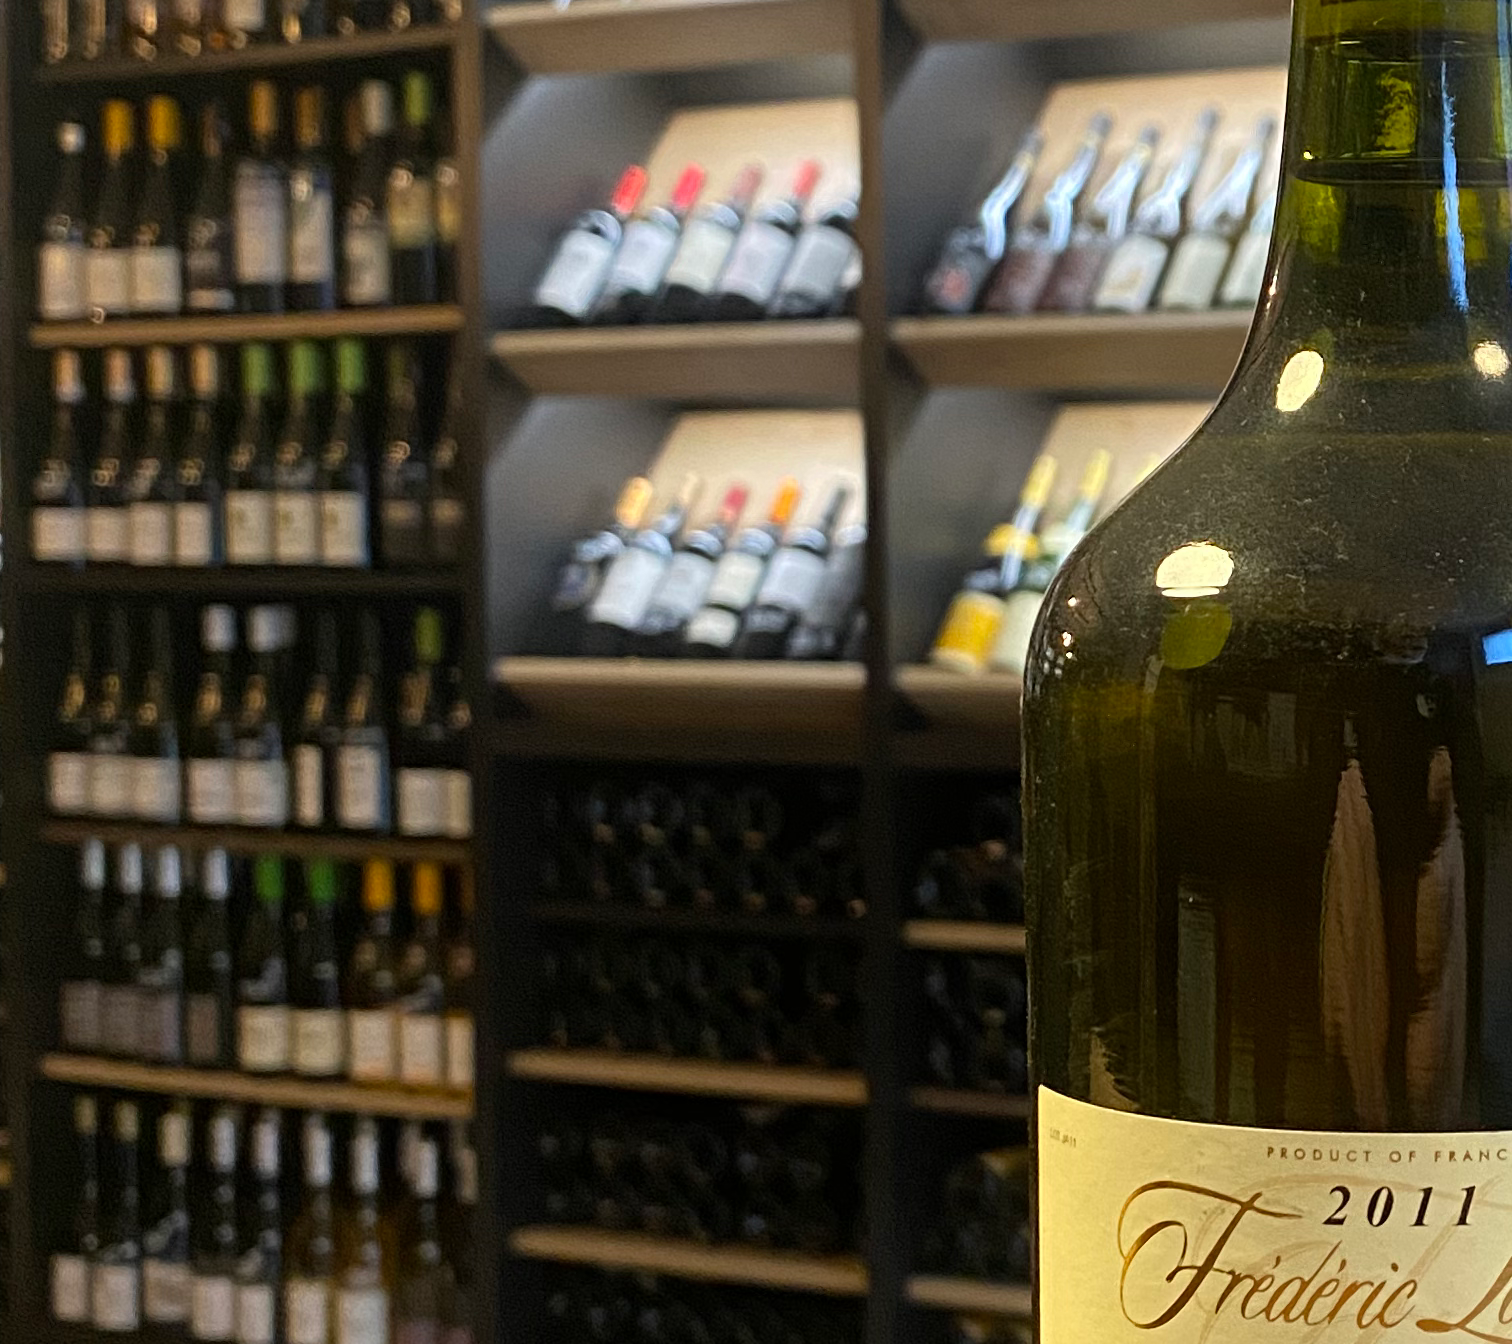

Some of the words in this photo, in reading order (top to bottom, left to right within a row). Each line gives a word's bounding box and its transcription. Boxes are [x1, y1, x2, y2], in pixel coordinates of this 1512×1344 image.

[1266, 1146, 1373, 1164] PRODUCT
[1388, 1150, 1418, 1164] OF
[1322, 1184, 1477, 1228] 2011
[1116, 1179, 1418, 1330] Frédéric
